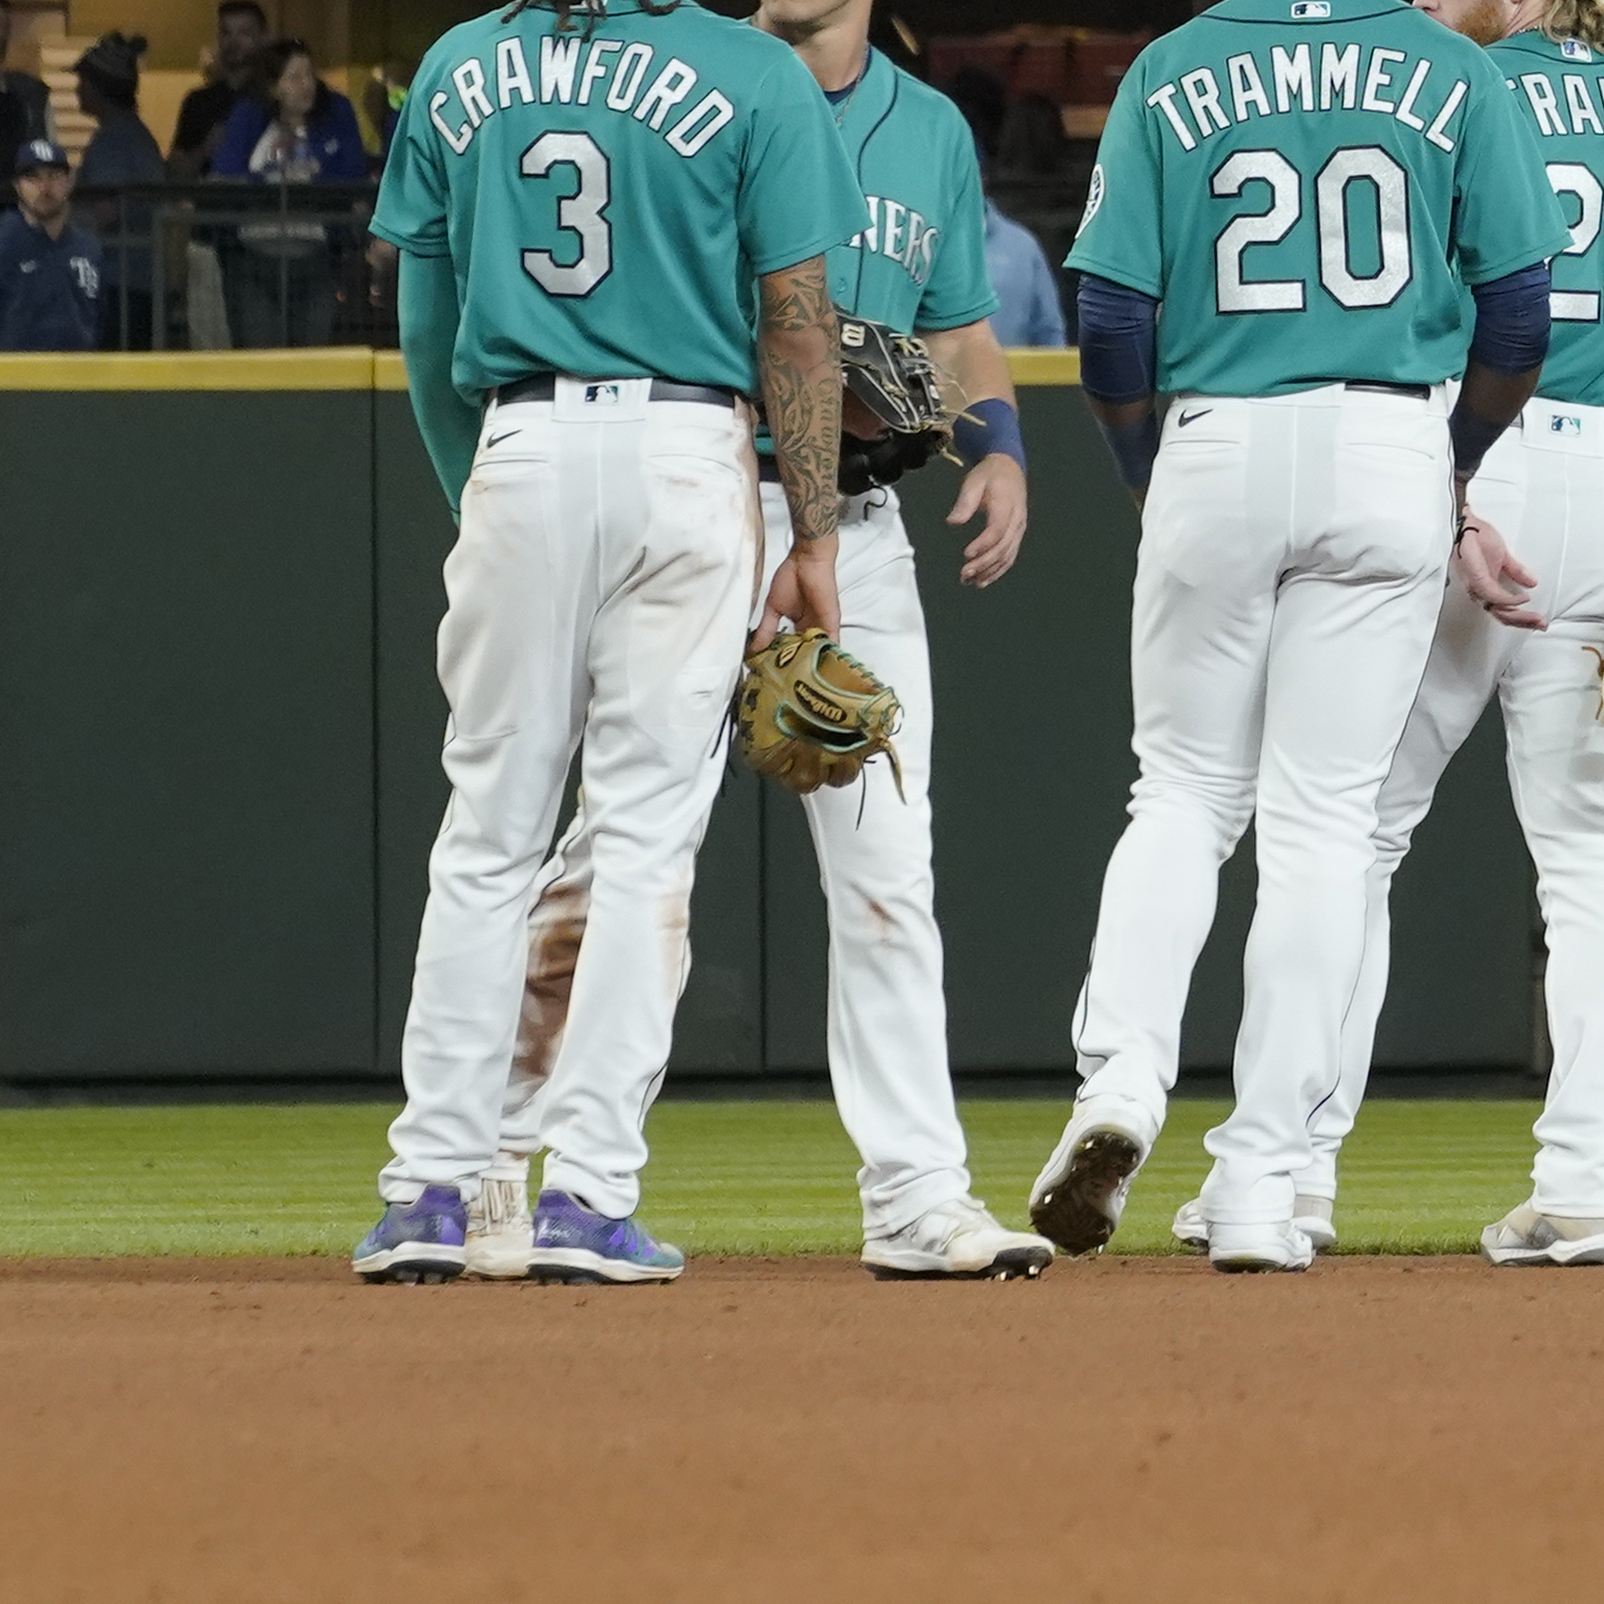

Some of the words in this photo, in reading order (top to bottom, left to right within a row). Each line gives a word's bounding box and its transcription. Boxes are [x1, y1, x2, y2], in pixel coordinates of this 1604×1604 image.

[428, 35, 735, 159] CRAWFORD
[1146, 42, 1470, 153] TRAMMELL
[520, 131, 613, 299] 3
[1209, 145, 1413, 315] 20
